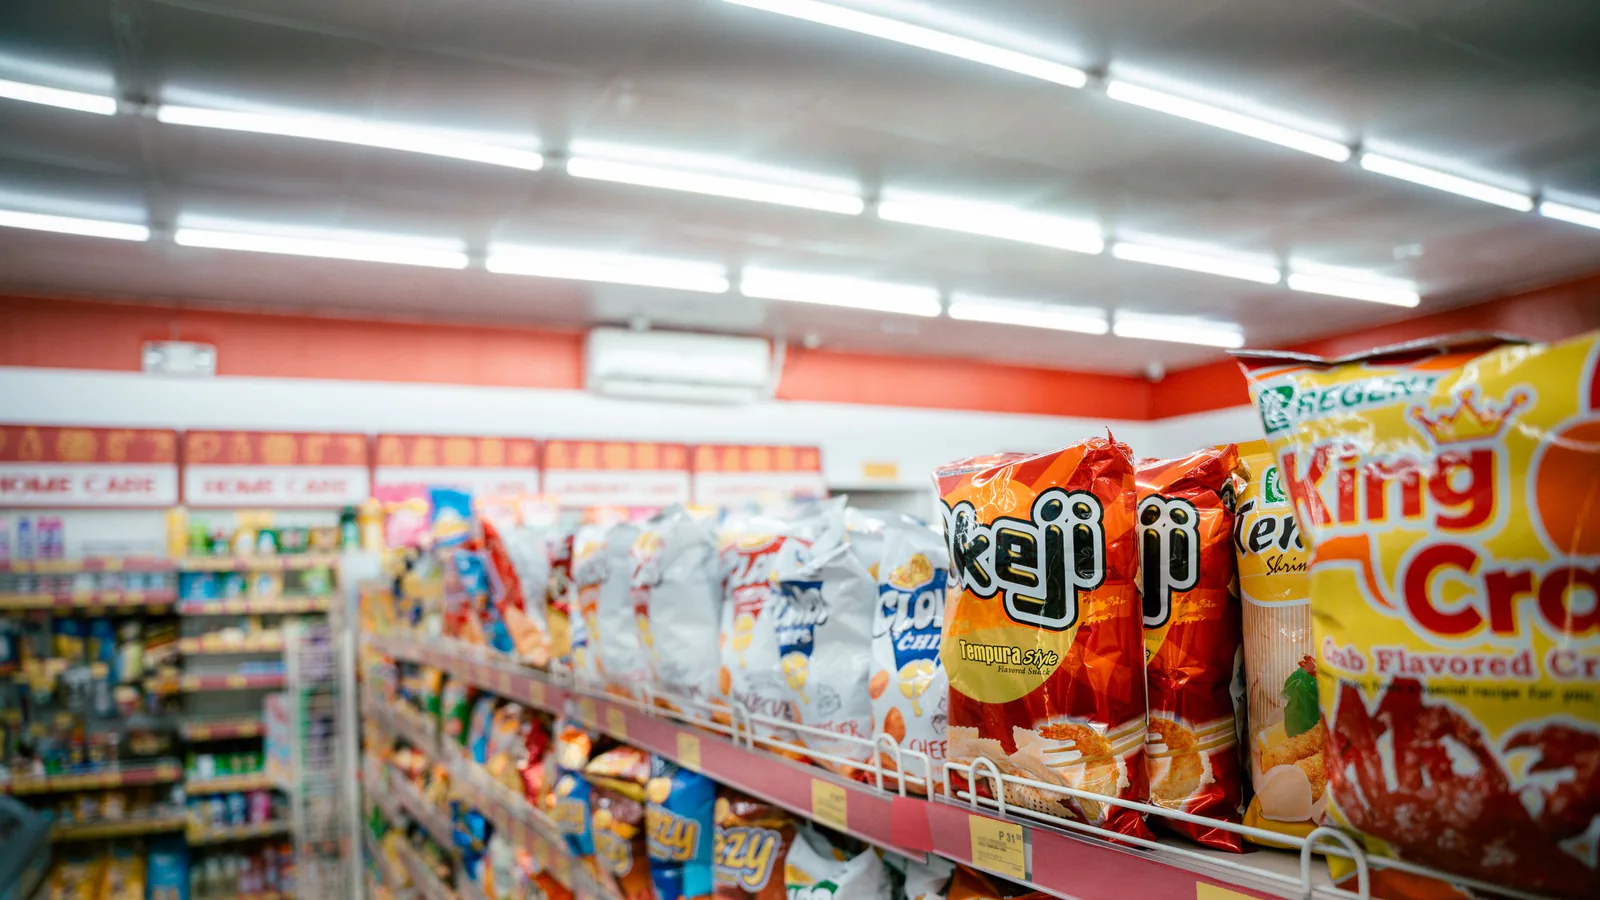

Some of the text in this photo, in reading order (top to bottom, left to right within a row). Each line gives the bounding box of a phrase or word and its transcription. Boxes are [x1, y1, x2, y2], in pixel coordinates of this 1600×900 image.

[0, 475, 156, 494] HOME CARE
[1280, 442, 1495, 532] King
[896, 632, 941, 652] CHI
[959, 639, 1059, 670] Tempura Style
[1325, 637, 1365, 672] ab
[1376, 647, 1535, 678] Flavored
[997, 665, 1051, 676] Flavored Snack
